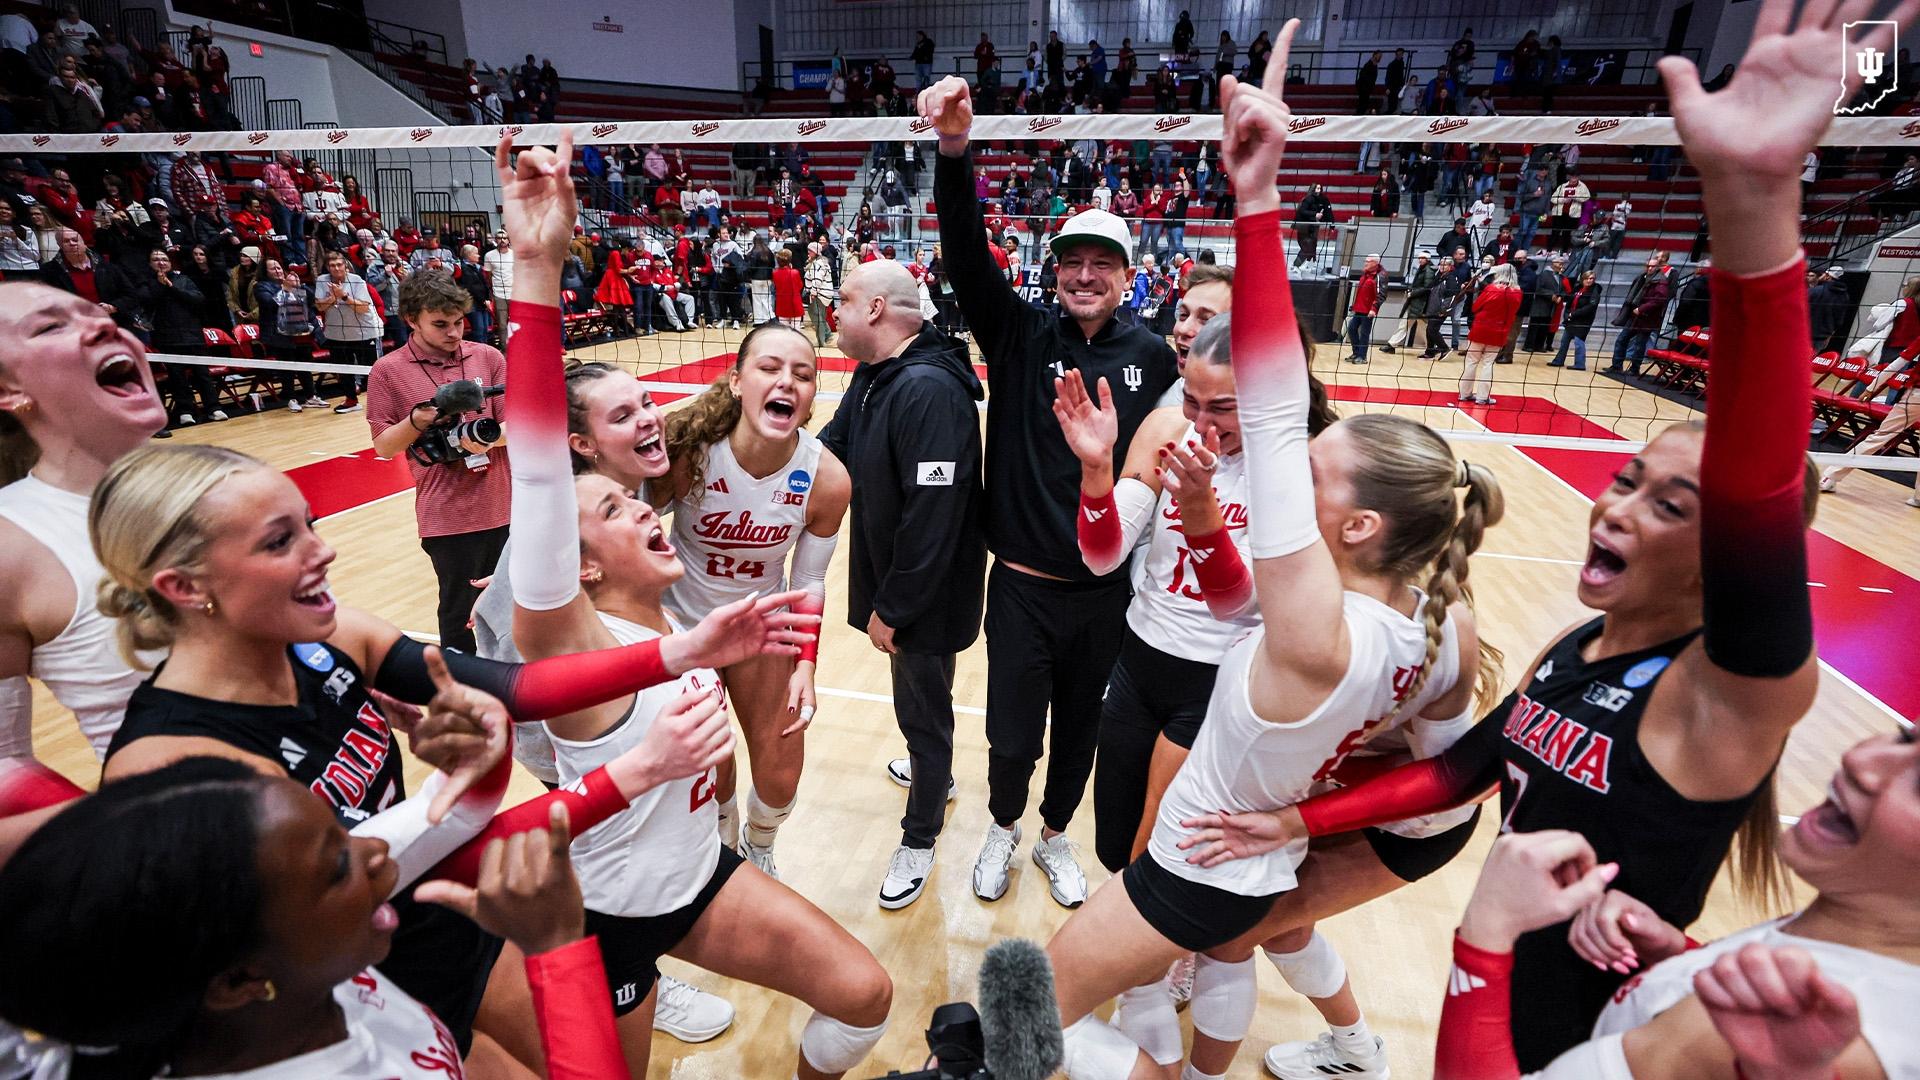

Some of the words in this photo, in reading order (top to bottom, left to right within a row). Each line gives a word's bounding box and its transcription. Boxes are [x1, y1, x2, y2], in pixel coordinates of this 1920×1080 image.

[800, 73, 832, 84] CHAMPI
[592, 123, 618, 137] Indiana
[691, 120, 720, 137] Indiana
[797, 119, 827, 136] Indiana
[1028, 116, 1062, 133] Indiana
[1154, 115, 1191, 132] Indiana
[1288, 116, 1326, 134] Indiana
[1427, 117, 1468, 135] Indiana
[1575, 117, 1619, 137] Indiana
[172, 132, 192, 146] Indiana
[248, 131, 269, 145] Indiana
[327, 129, 348, 143] Indiana
[410, 128, 433, 141] Indiana
[789, 479, 810, 489] NCAA
[772, 491, 805, 507] BIG
[692, 510, 794, 550] Indiana
[706, 553, 766, 580] 24
